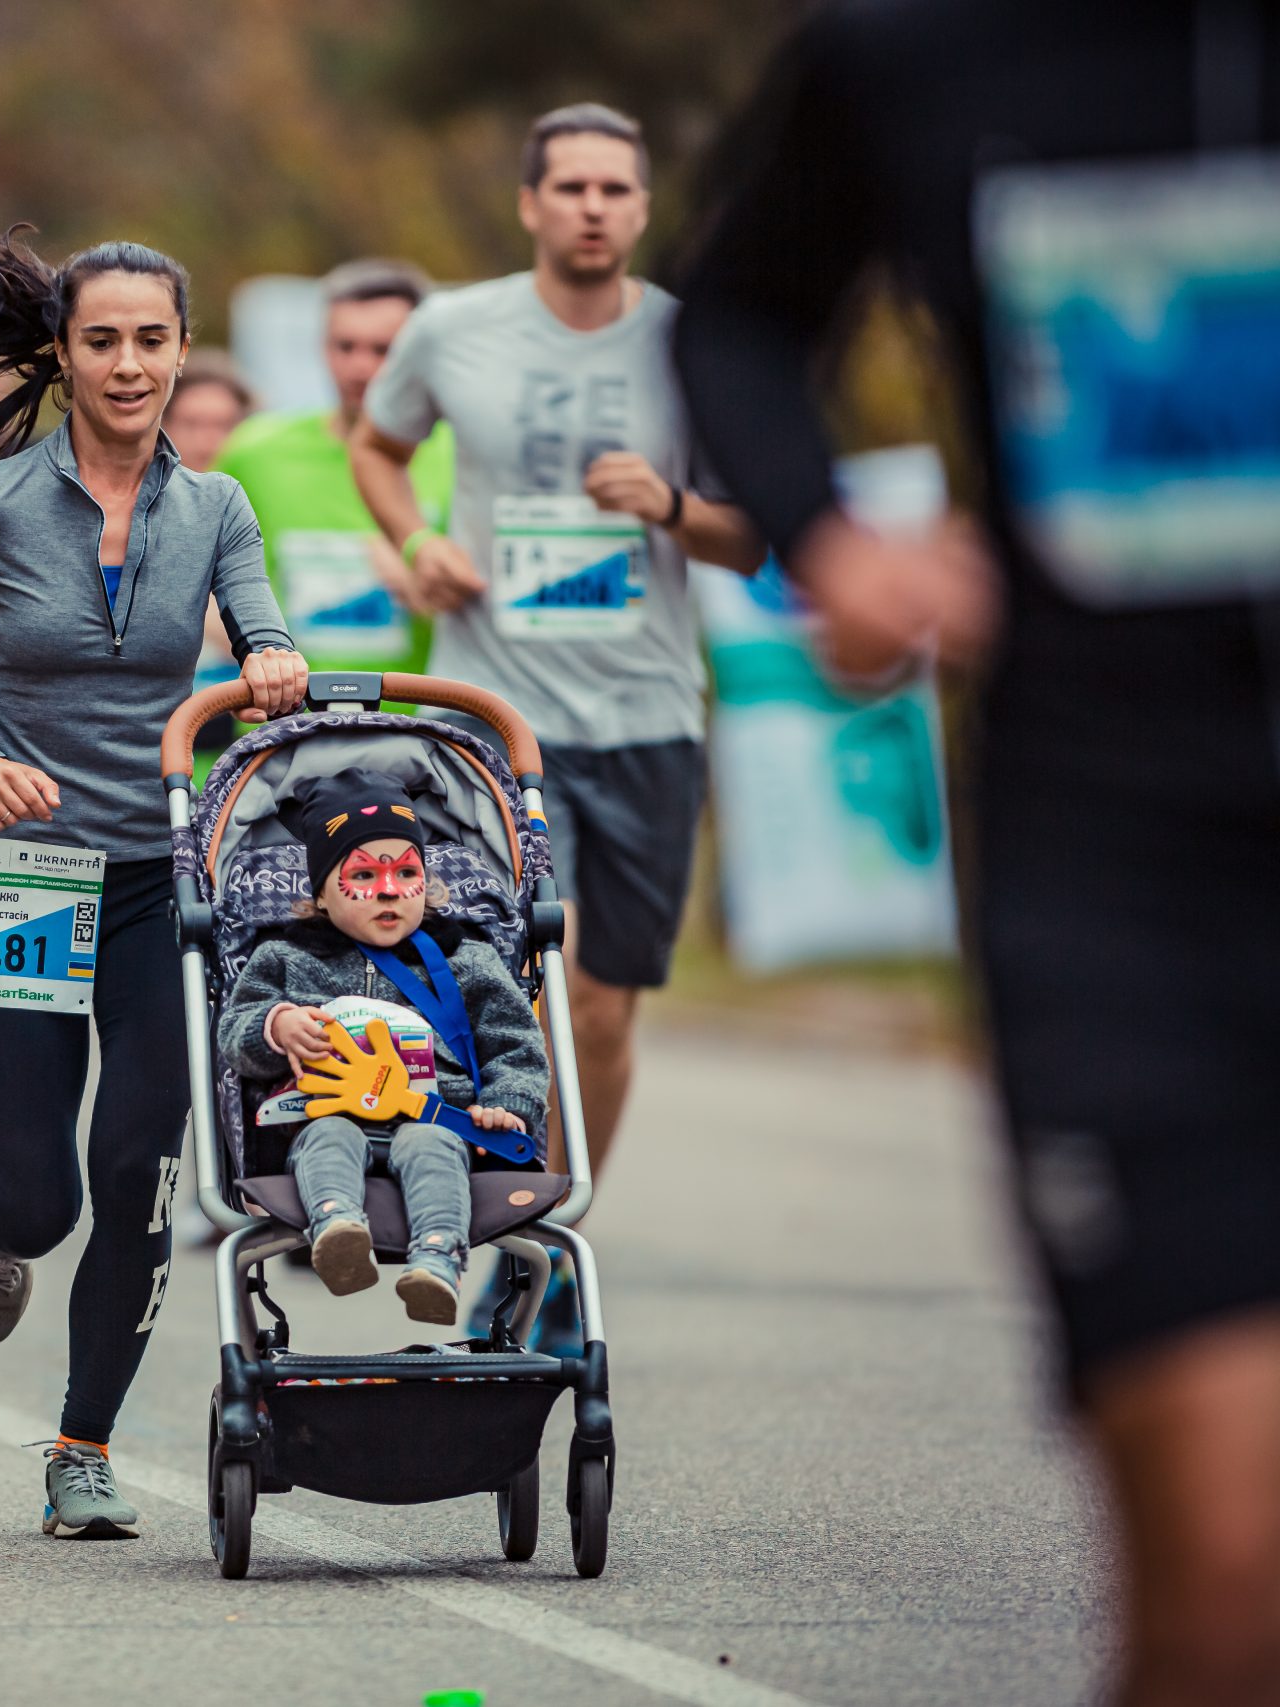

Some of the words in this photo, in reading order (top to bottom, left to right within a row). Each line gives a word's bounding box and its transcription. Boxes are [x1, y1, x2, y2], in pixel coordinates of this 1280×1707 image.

[34, 853, 100, 869] UKRNAFTA
[424, 848, 454, 866] ECT
[448, 876, 501, 899] TRUS
[437, 901, 497, 917] OVE
[280, 1100, 305, 1111] STAR
